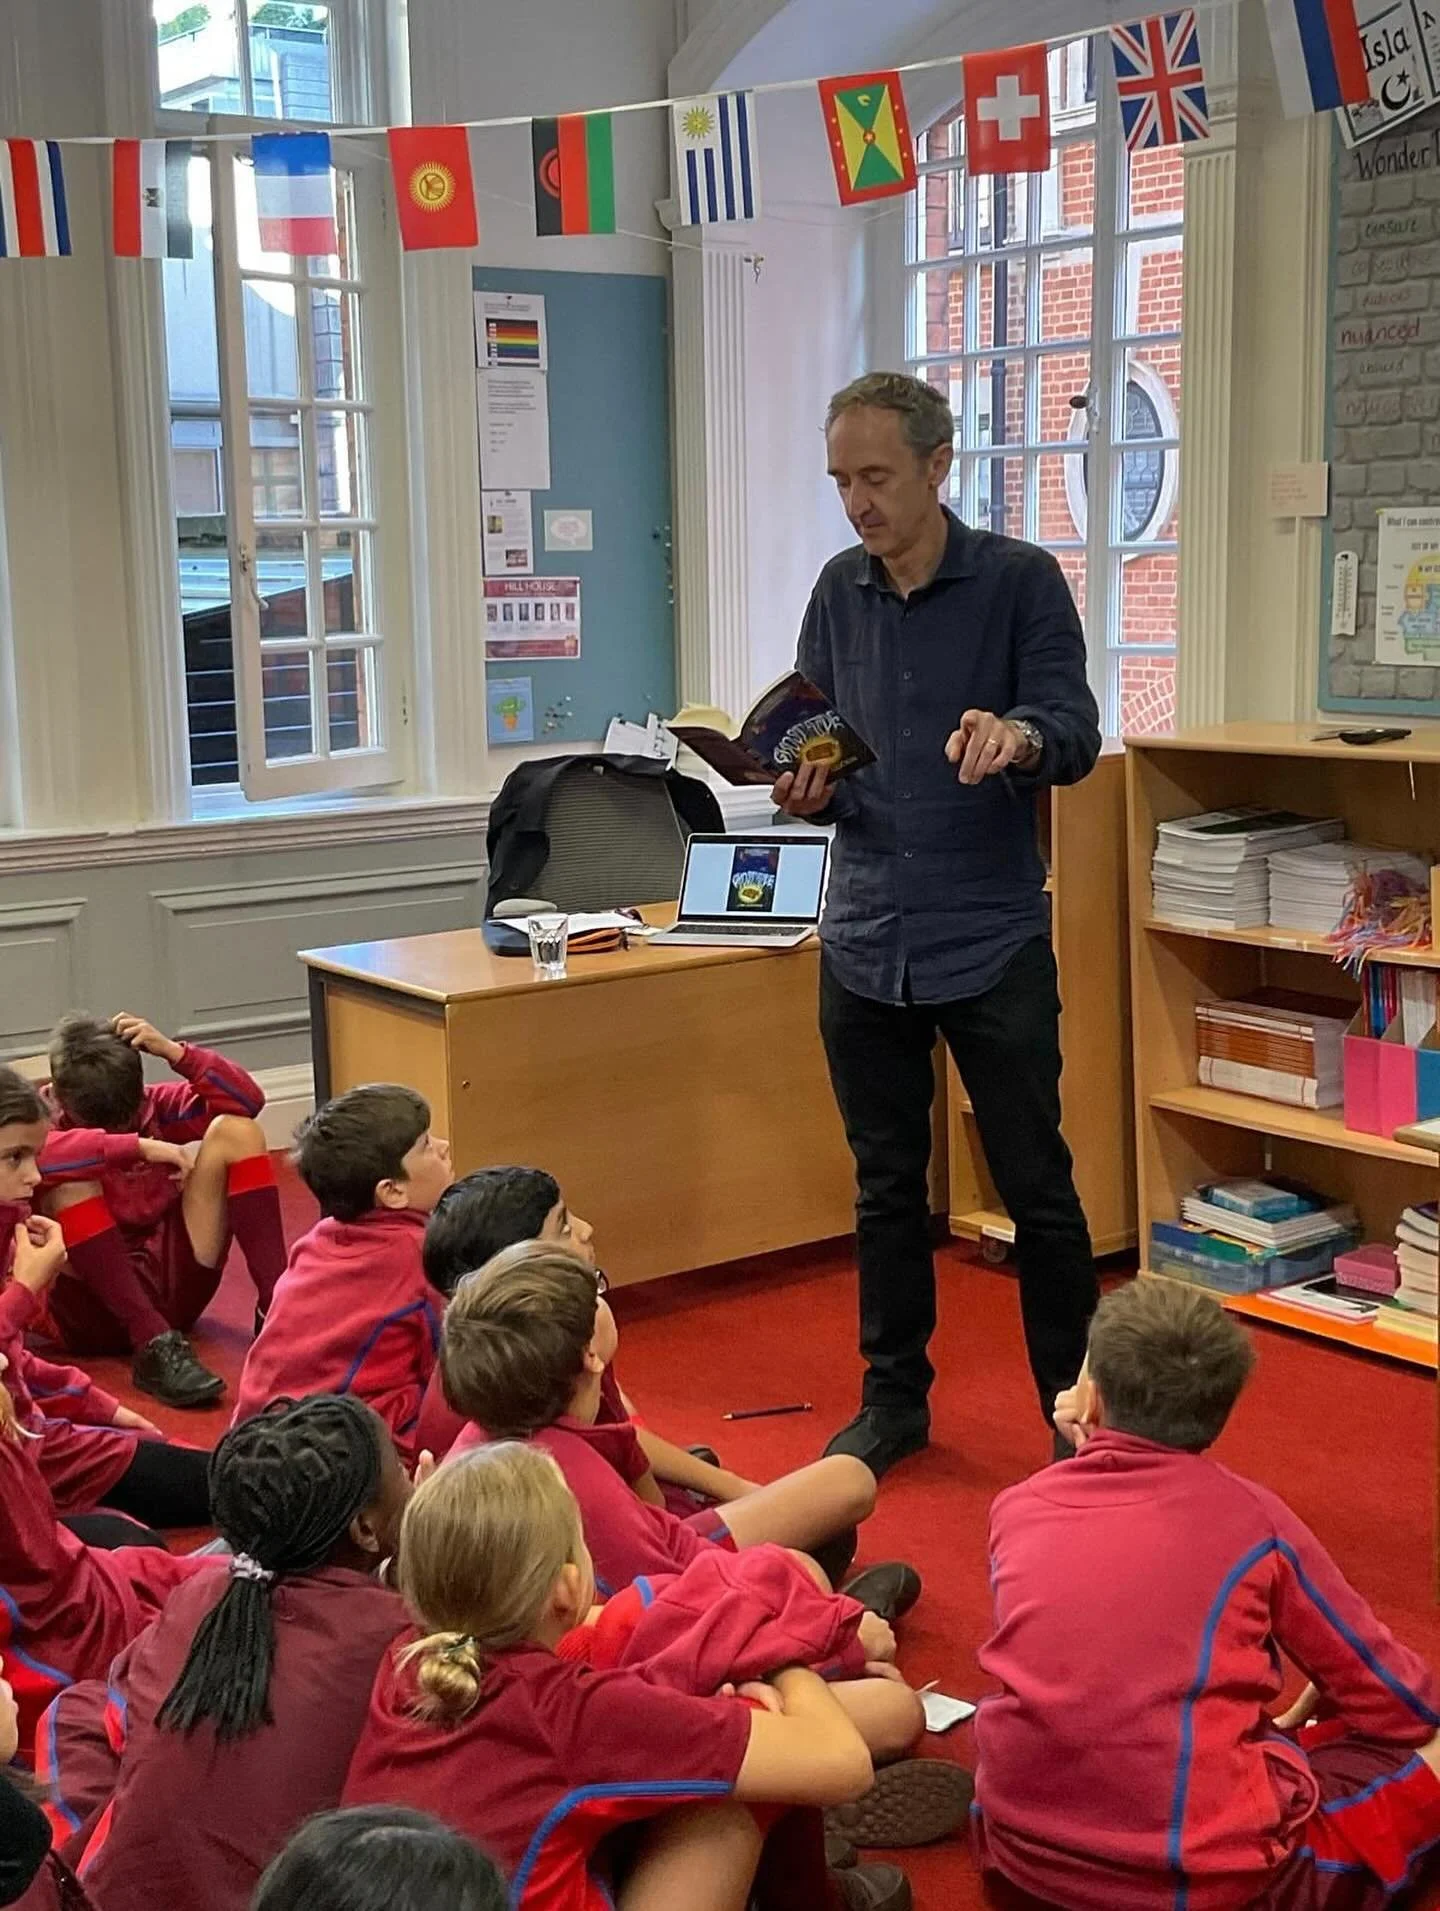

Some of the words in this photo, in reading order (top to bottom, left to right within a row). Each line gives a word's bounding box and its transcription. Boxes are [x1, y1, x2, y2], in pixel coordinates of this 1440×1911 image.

[1353, 137, 1430, 180] Wonder
[1341, 316, 1419, 345] nuanced
[503, 581, 523, 592] HILL
[525, 580, 557, 592] HOUSE
